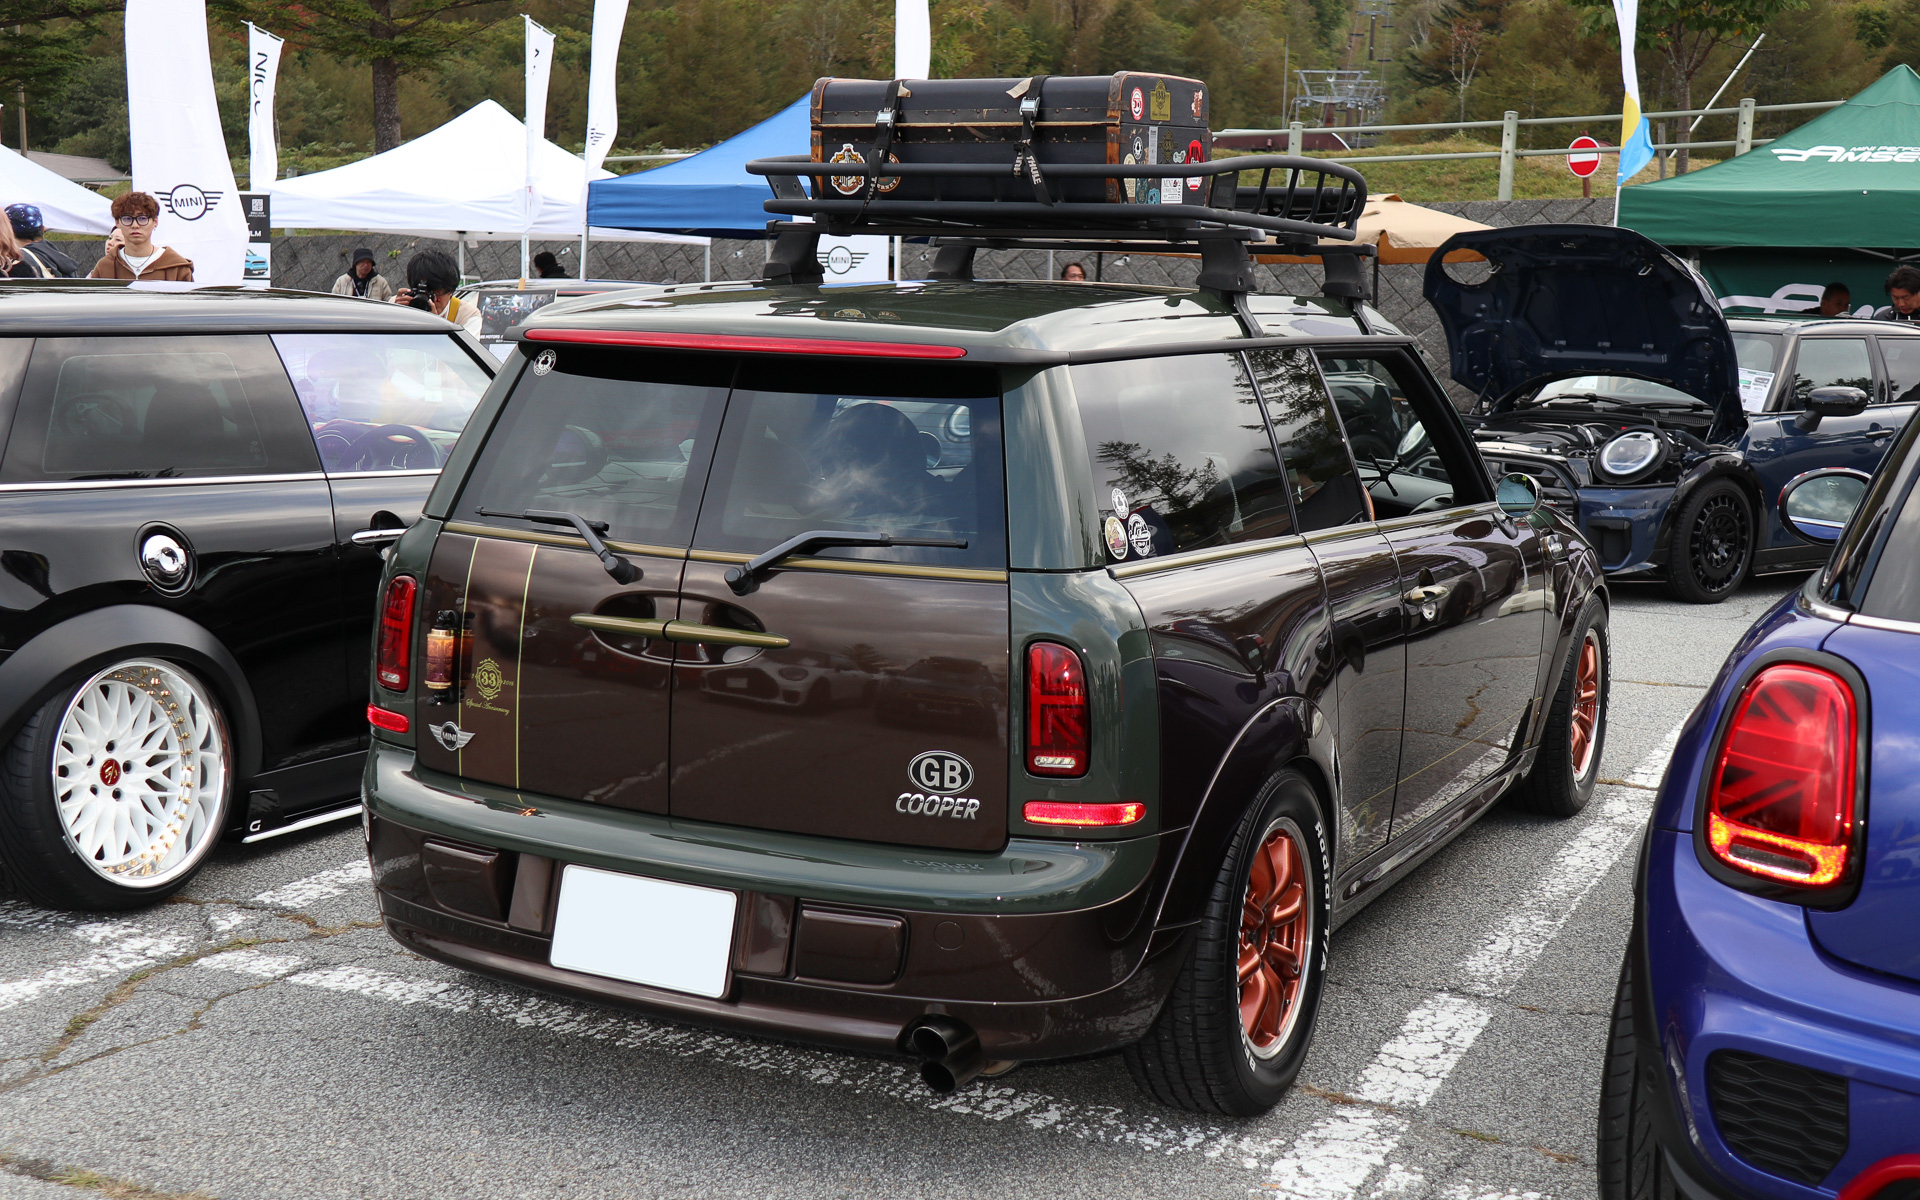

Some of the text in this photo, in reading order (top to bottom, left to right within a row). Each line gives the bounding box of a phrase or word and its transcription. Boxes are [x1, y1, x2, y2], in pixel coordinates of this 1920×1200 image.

[1771, 145, 1920, 162] AMSE
[1025, 155, 1042, 185] THULE
[877, 179, 897, 190] URNEY
[174, 197, 203, 208] MINI
[481, 671, 497, 687] 33
[442, 731, 457, 742] MINI
[919, 757, 962, 789] GB
[895, 793, 980, 819] COOPER
[1314, 820, 1331, 972] Radial T/A
